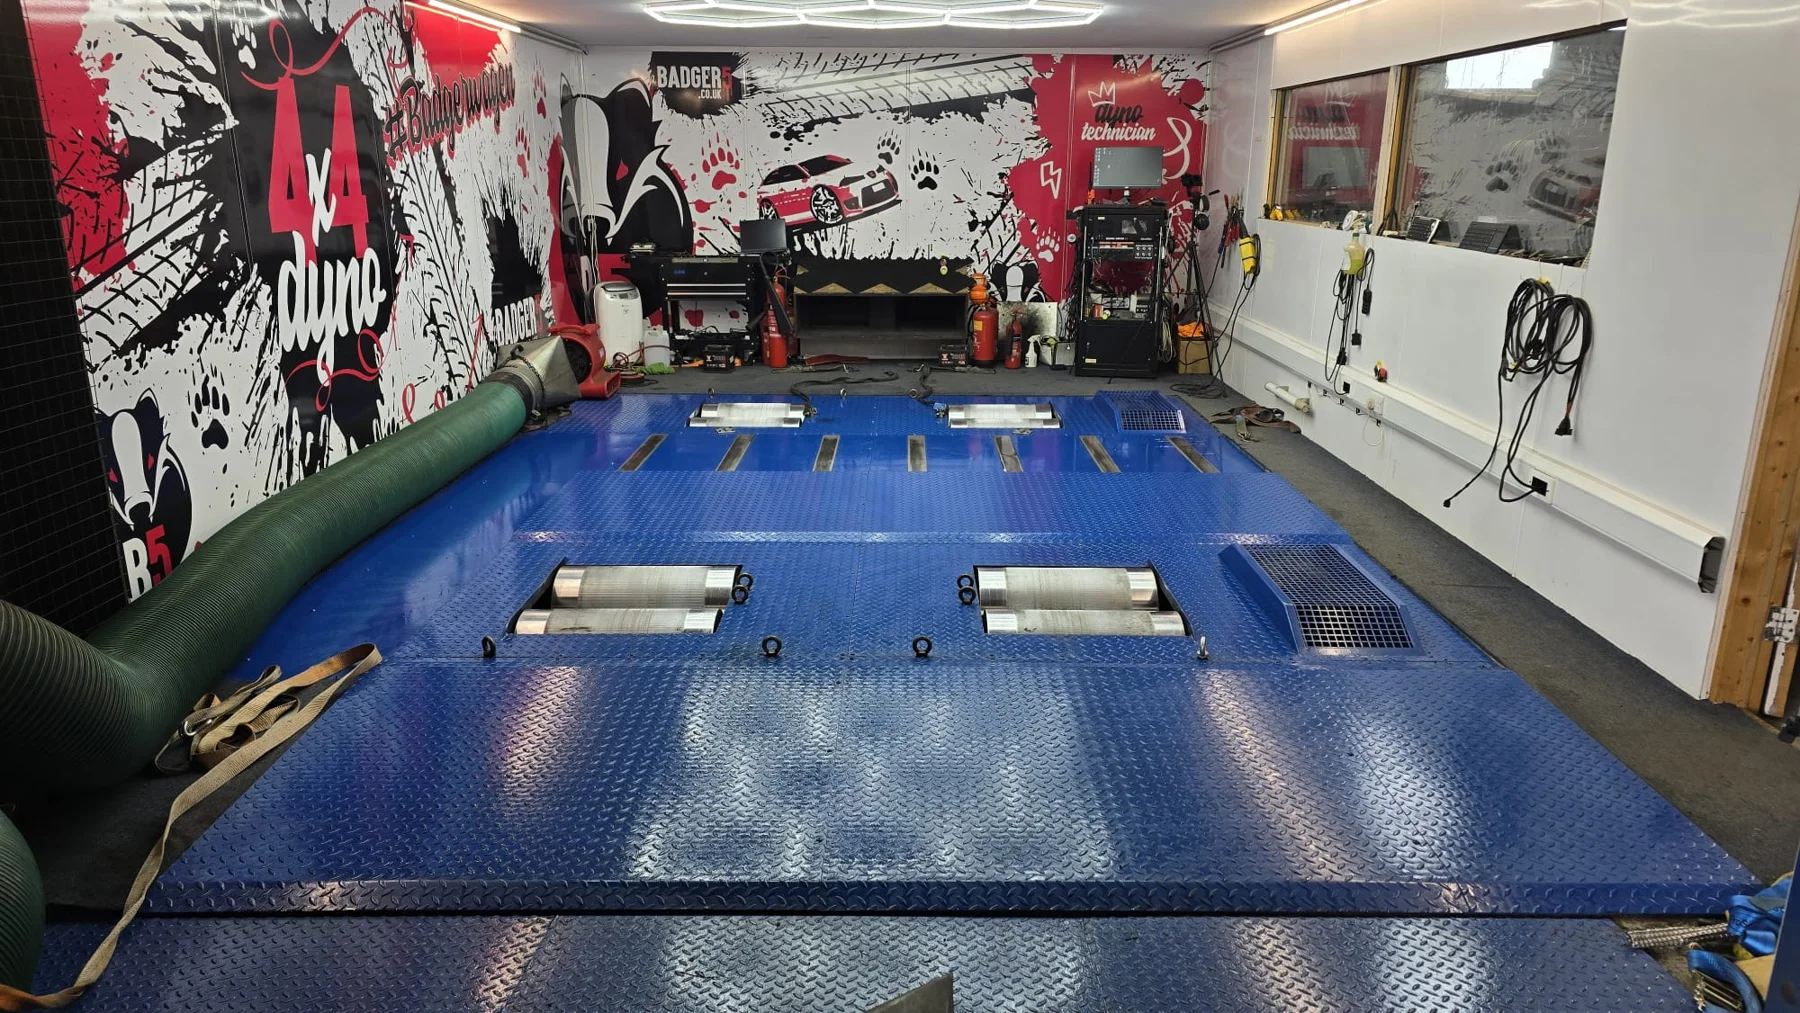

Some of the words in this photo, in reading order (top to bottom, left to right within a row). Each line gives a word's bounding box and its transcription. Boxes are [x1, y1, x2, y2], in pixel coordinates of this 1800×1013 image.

[656, 65, 733, 89] BADGER5
[698, 89, 722, 100] .CO.UK
[383, 63, 516, 164] #Badgerwagen
[1094, 101, 1144, 128] dyno
[1081, 122, 1156, 141] technician
[277, 230, 387, 386] dyno
[122, 525, 173, 603] B5
